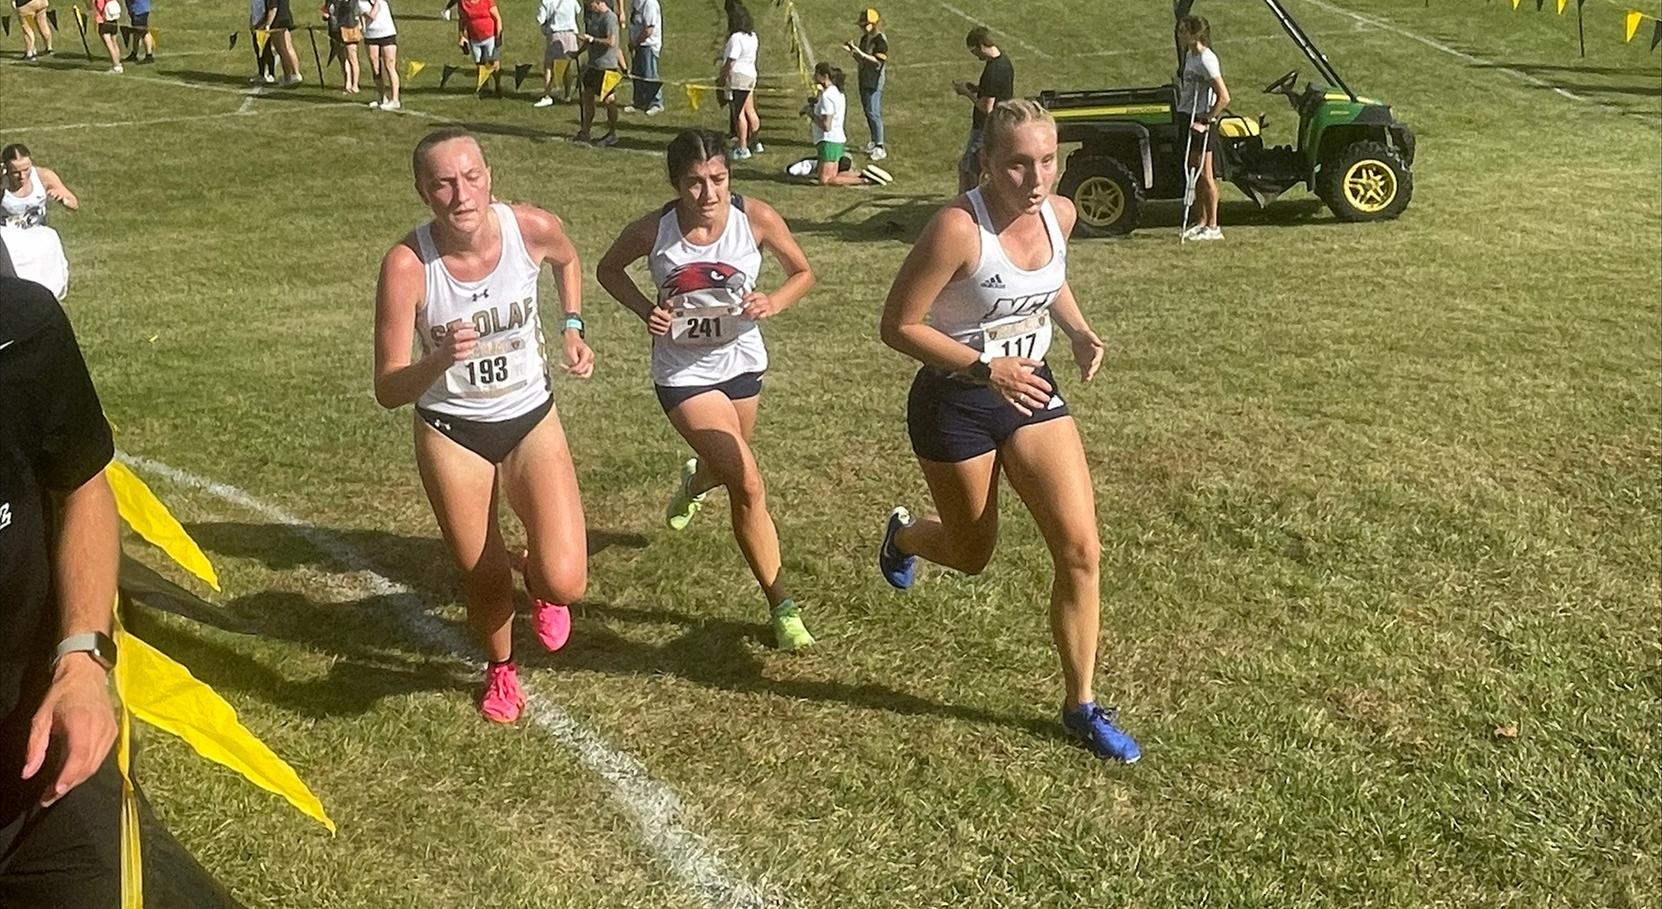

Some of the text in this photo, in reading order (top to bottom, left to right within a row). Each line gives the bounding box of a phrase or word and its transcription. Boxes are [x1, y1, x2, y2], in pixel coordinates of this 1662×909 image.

[472, 297, 533, 338] OLAF
[687, 317, 722, 339] 241
[1001, 332, 1037, 359] 117
[465, 355, 509, 386] 193
